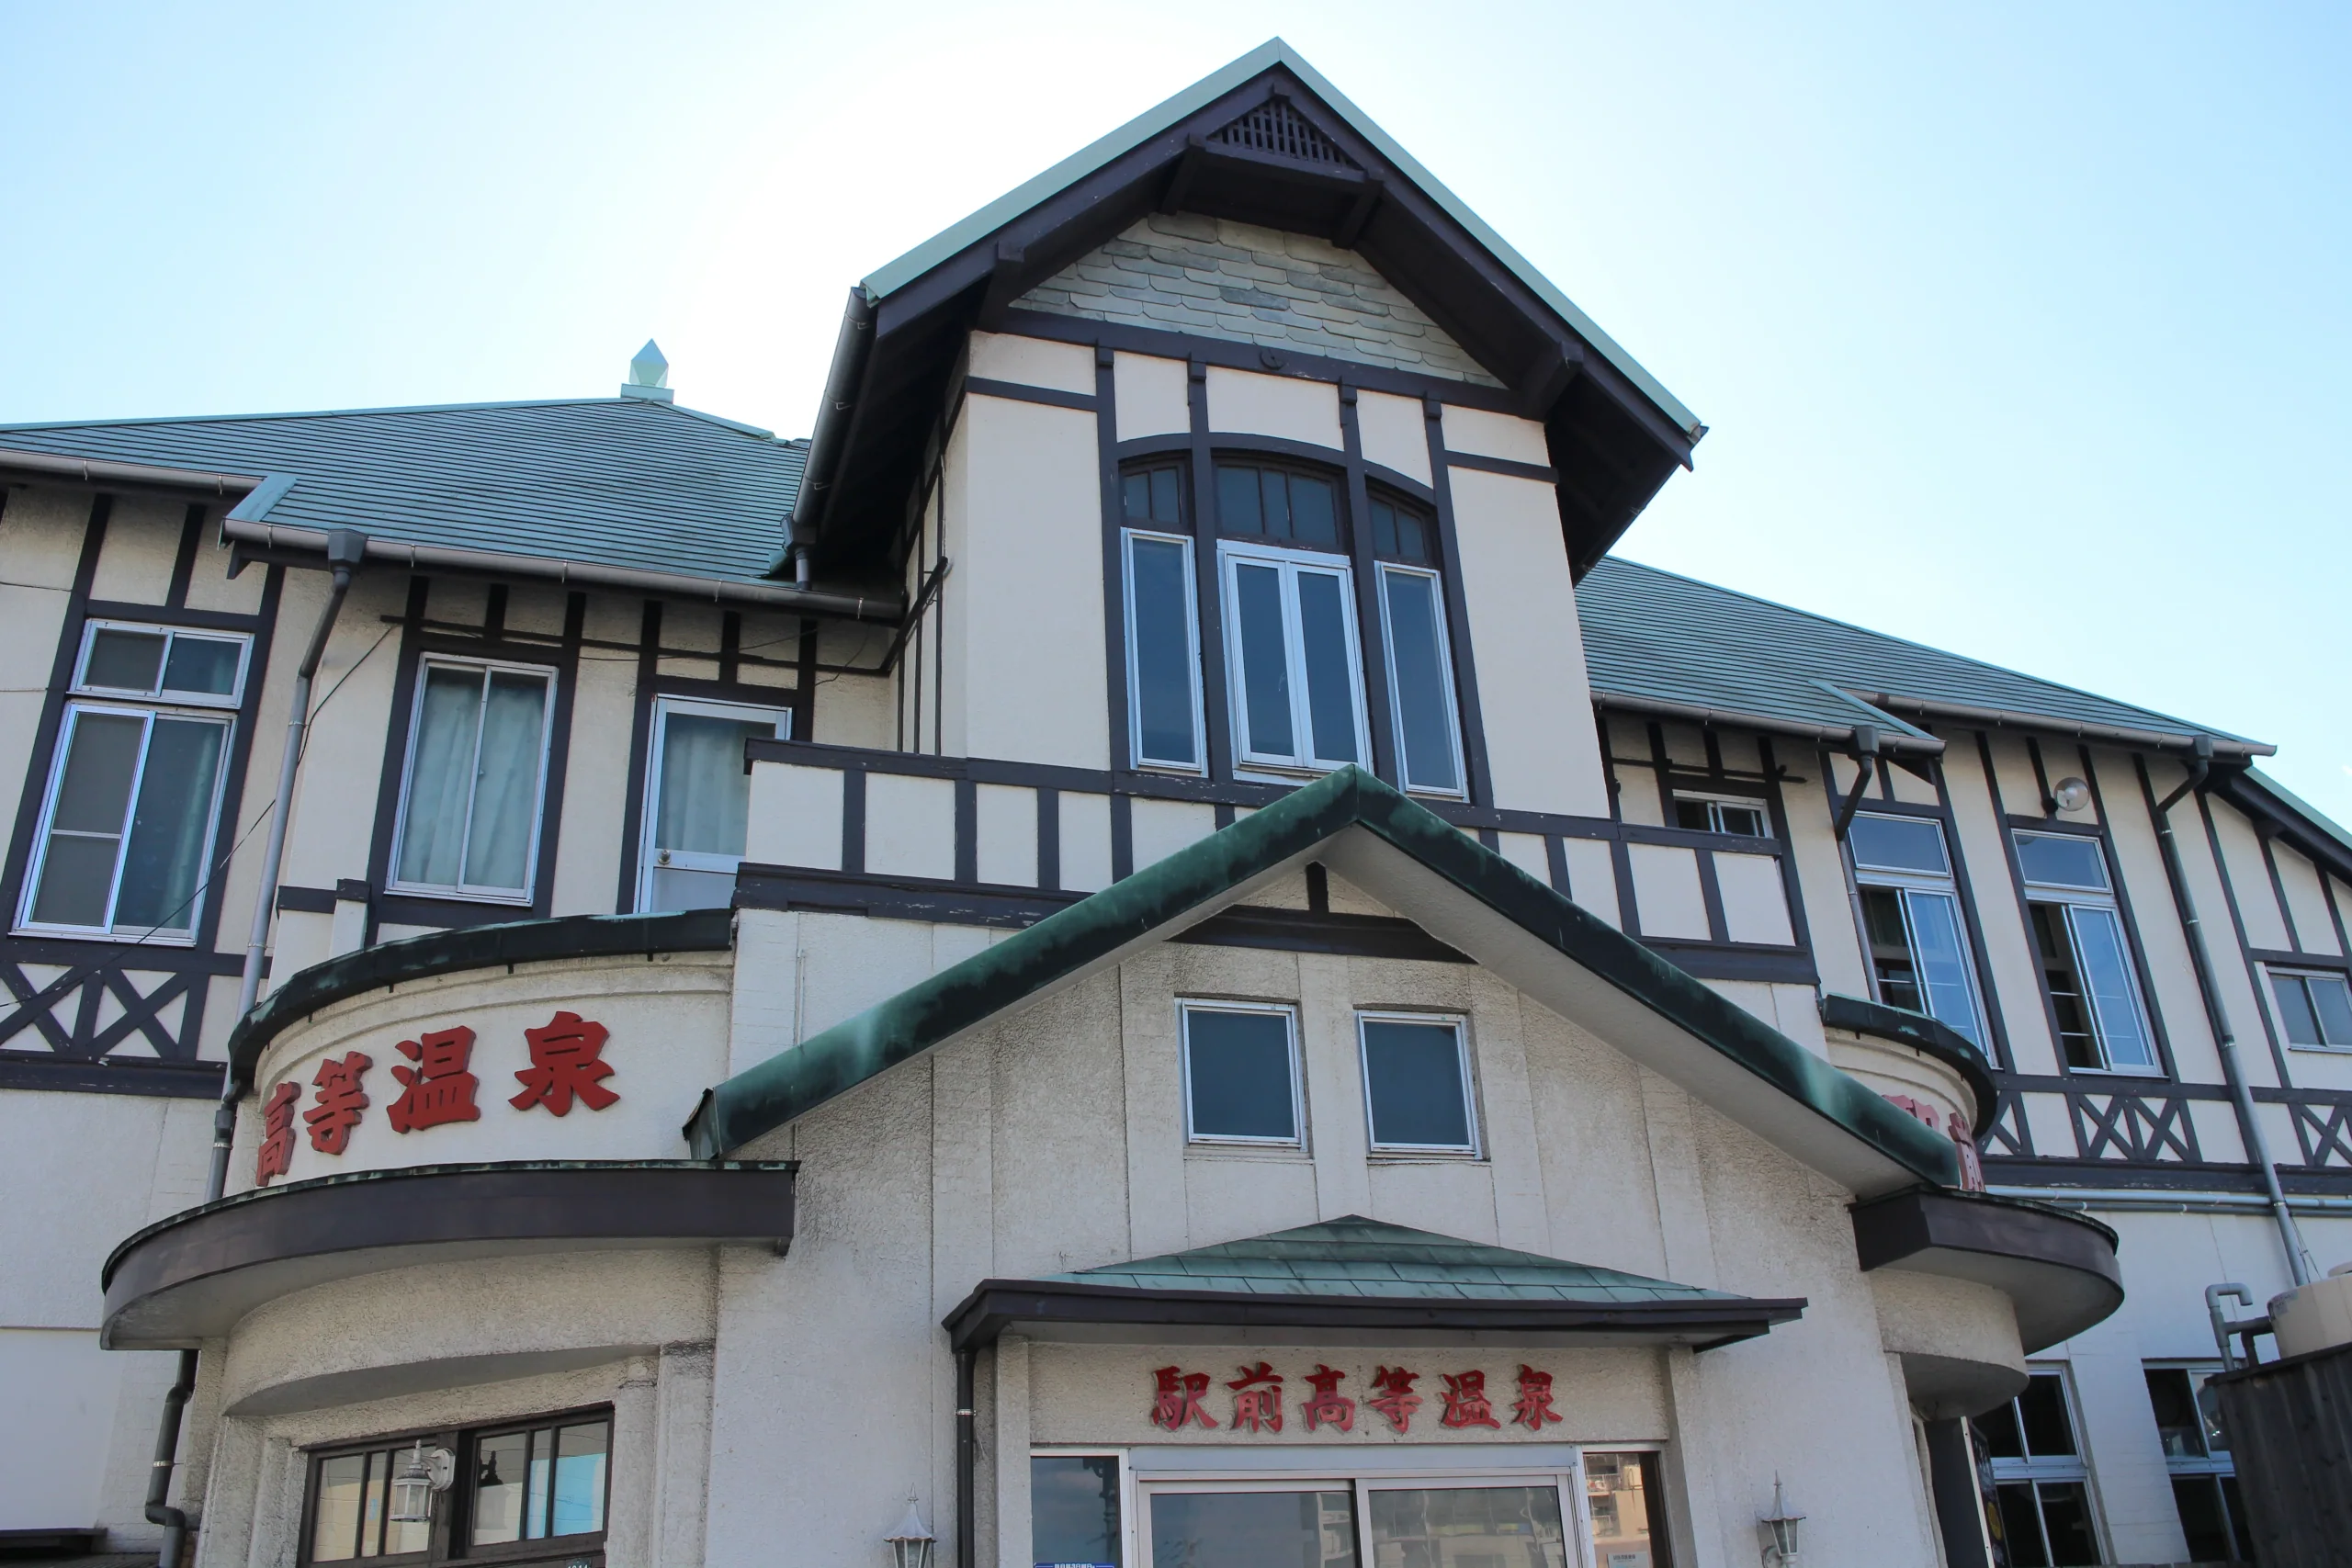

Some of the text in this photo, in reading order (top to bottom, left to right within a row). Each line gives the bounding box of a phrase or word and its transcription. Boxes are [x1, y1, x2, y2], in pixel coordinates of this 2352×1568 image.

[255, 1010, 621, 1187] 高等温泉
[1151, 1361, 1564, 1433] 駅前高等温泉
